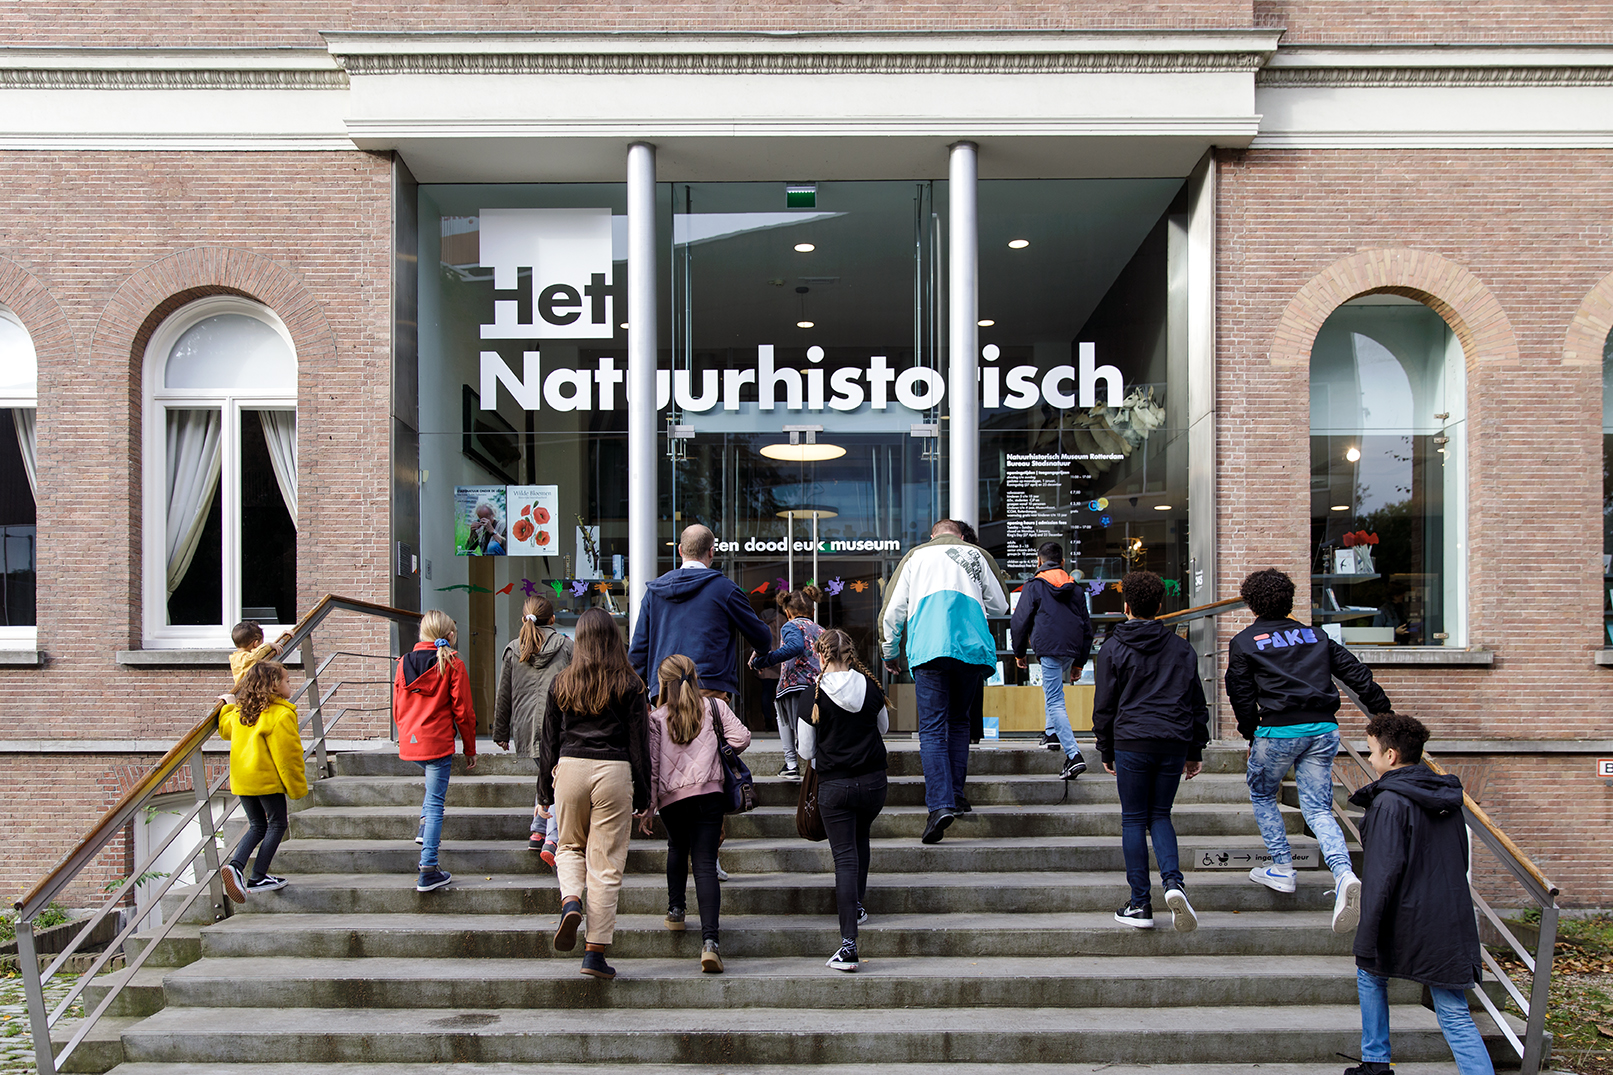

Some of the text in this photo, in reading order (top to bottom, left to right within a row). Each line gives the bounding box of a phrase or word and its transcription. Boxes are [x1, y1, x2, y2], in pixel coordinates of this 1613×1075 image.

[480, 267, 613, 325] Het
[480, 343, 1124, 412] Naturhistoisch
[744, 536, 826, 552] doodeuk
[831, 540, 900, 551] museum
[1253, 629, 1318, 650] FAKE
